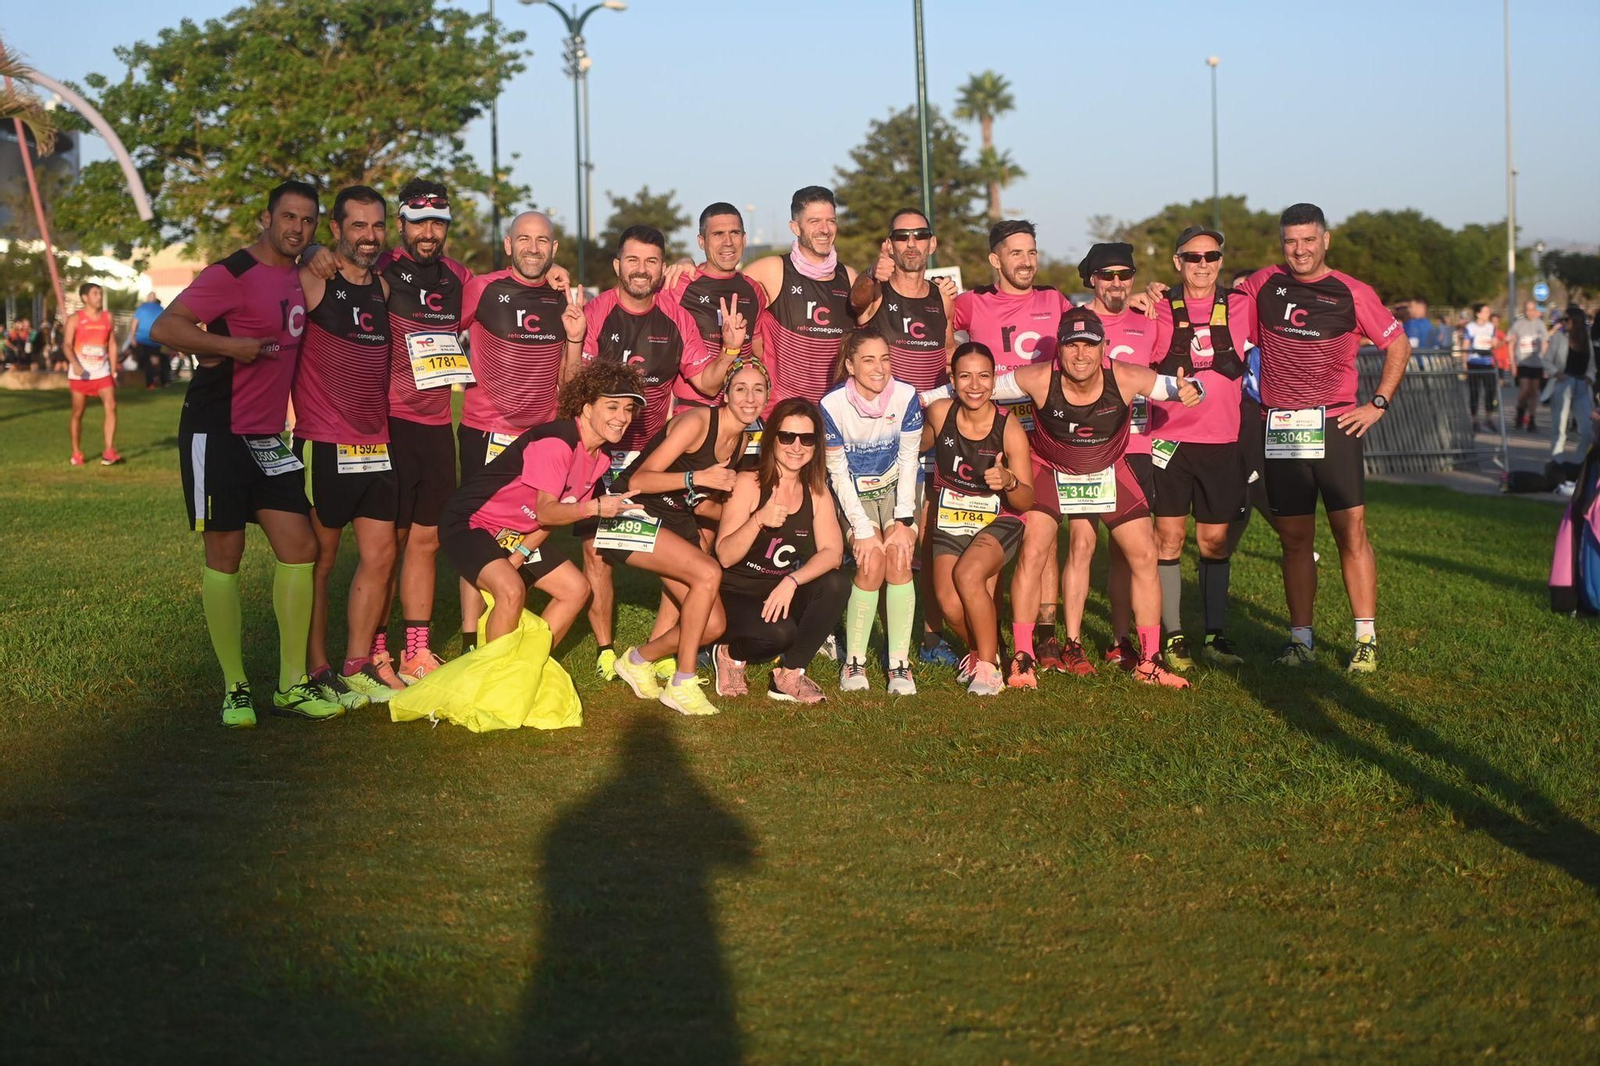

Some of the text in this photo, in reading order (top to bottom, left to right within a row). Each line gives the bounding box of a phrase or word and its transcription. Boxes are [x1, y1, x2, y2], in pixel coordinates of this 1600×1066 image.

[429, 356, 457, 369] 1781
[1280, 431, 1311, 443] 3045
[351, 443, 378, 455] 1592
[1070, 485, 1100, 498] 3140
[953, 510, 984, 522] 1784
[611, 519, 642, 533] 3499
